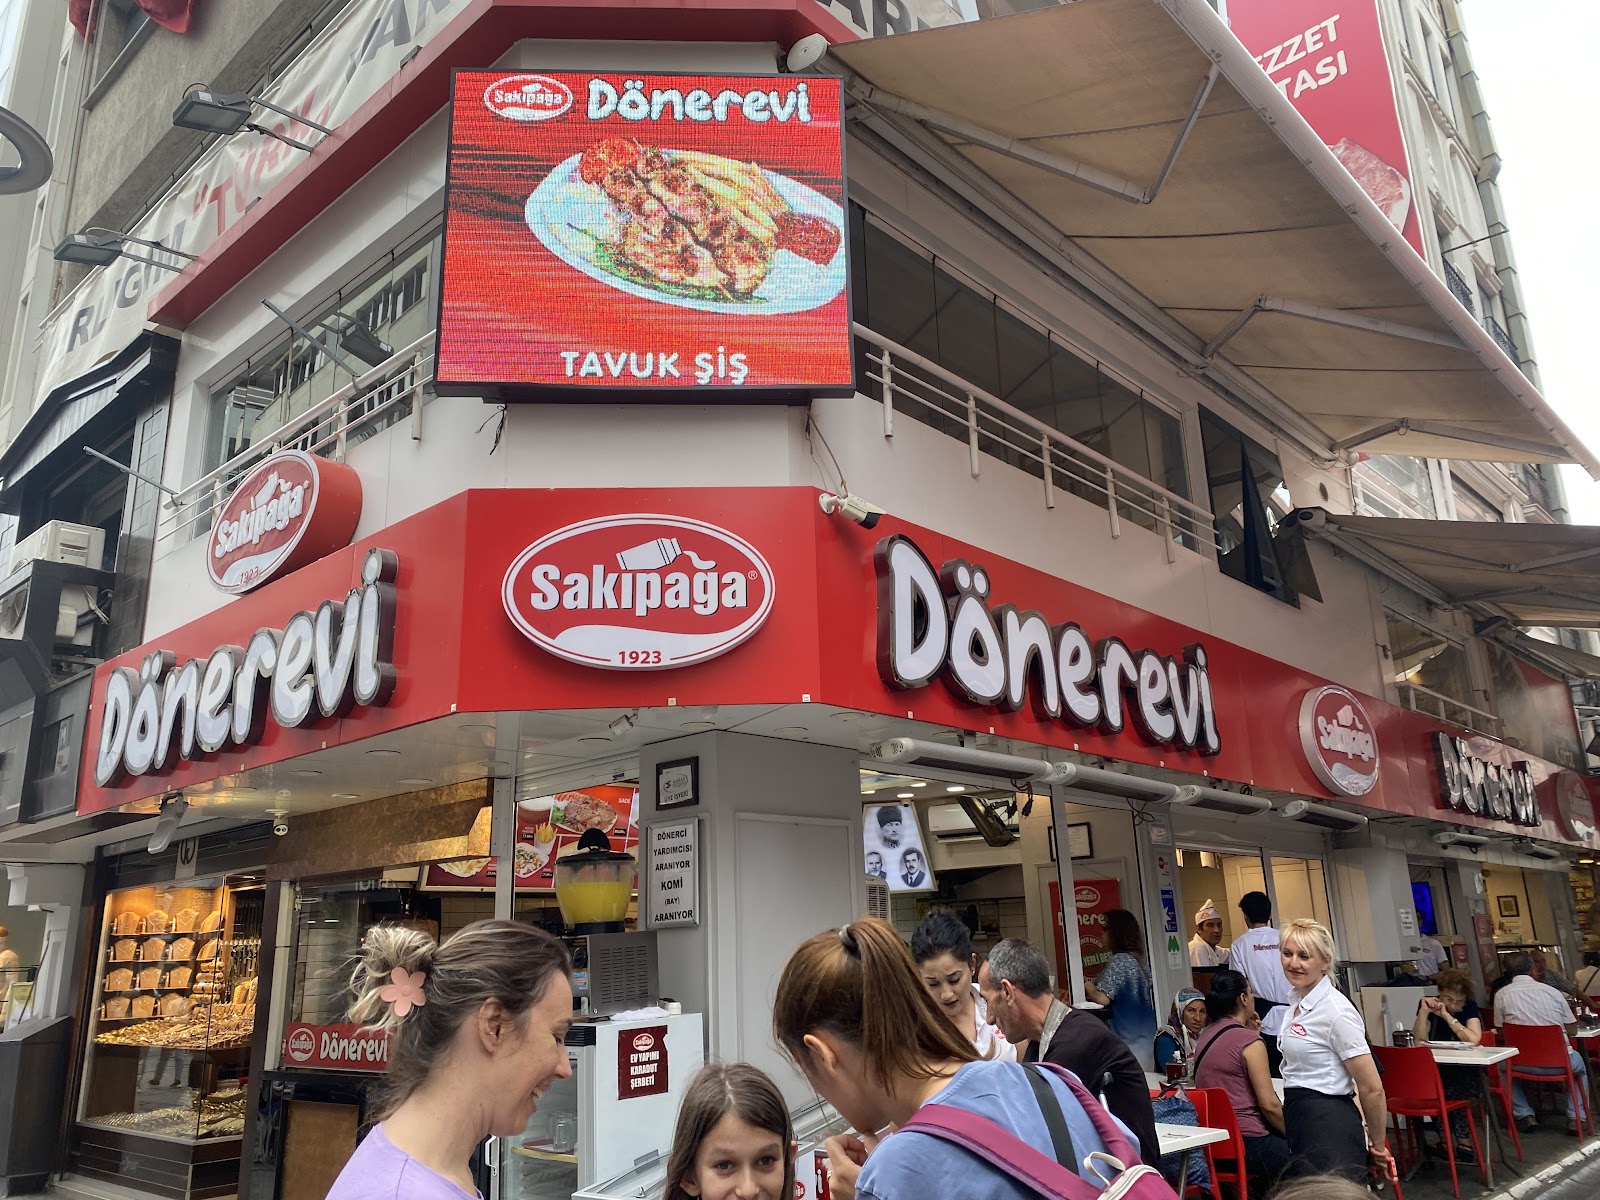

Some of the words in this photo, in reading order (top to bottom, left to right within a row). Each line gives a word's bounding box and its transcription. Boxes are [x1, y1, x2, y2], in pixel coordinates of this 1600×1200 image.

[587, 78, 812, 123] Dönerevi
[560, 351, 681, 380] TAVUK
[695, 346, 750, 385] ŞİŞ
[876, 534, 1222, 757] Dönerevi
[618, 650, 662, 665] 1923
[94, 548, 390, 788] Dönerevi
[657, 827, 687, 841] DÖNERCİ
[655, 860, 691, 872] ARANIYOR
[661, 876, 683, 891] KOMİ
[664, 897, 680, 907] (BAY)
[654, 909, 693, 922] ARANIYOR
[630, 1053, 638, 1064] EV
[630, 1074, 655, 1090] ŞERBETİ
